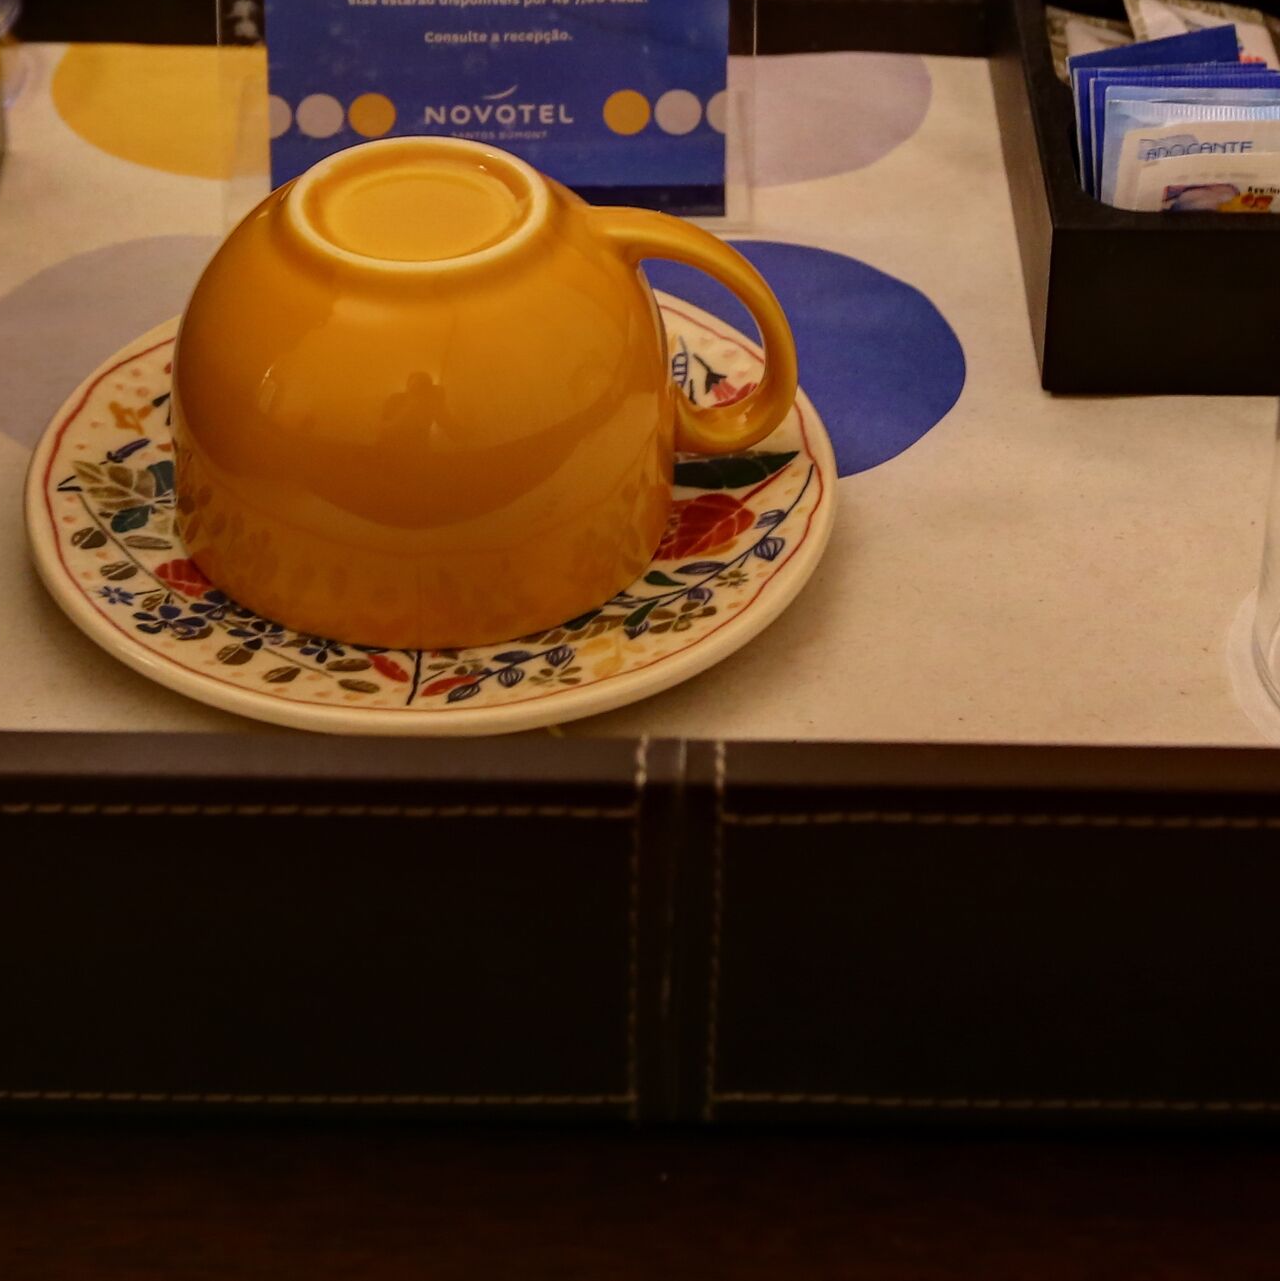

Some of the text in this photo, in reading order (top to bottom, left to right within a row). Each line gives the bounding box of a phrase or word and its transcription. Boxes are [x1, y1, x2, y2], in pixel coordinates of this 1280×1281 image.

[423, 30, 488, 44] Consulte
[490, 33, 500, 44] a
[424, 103, 574, 125] NOVOTEL
